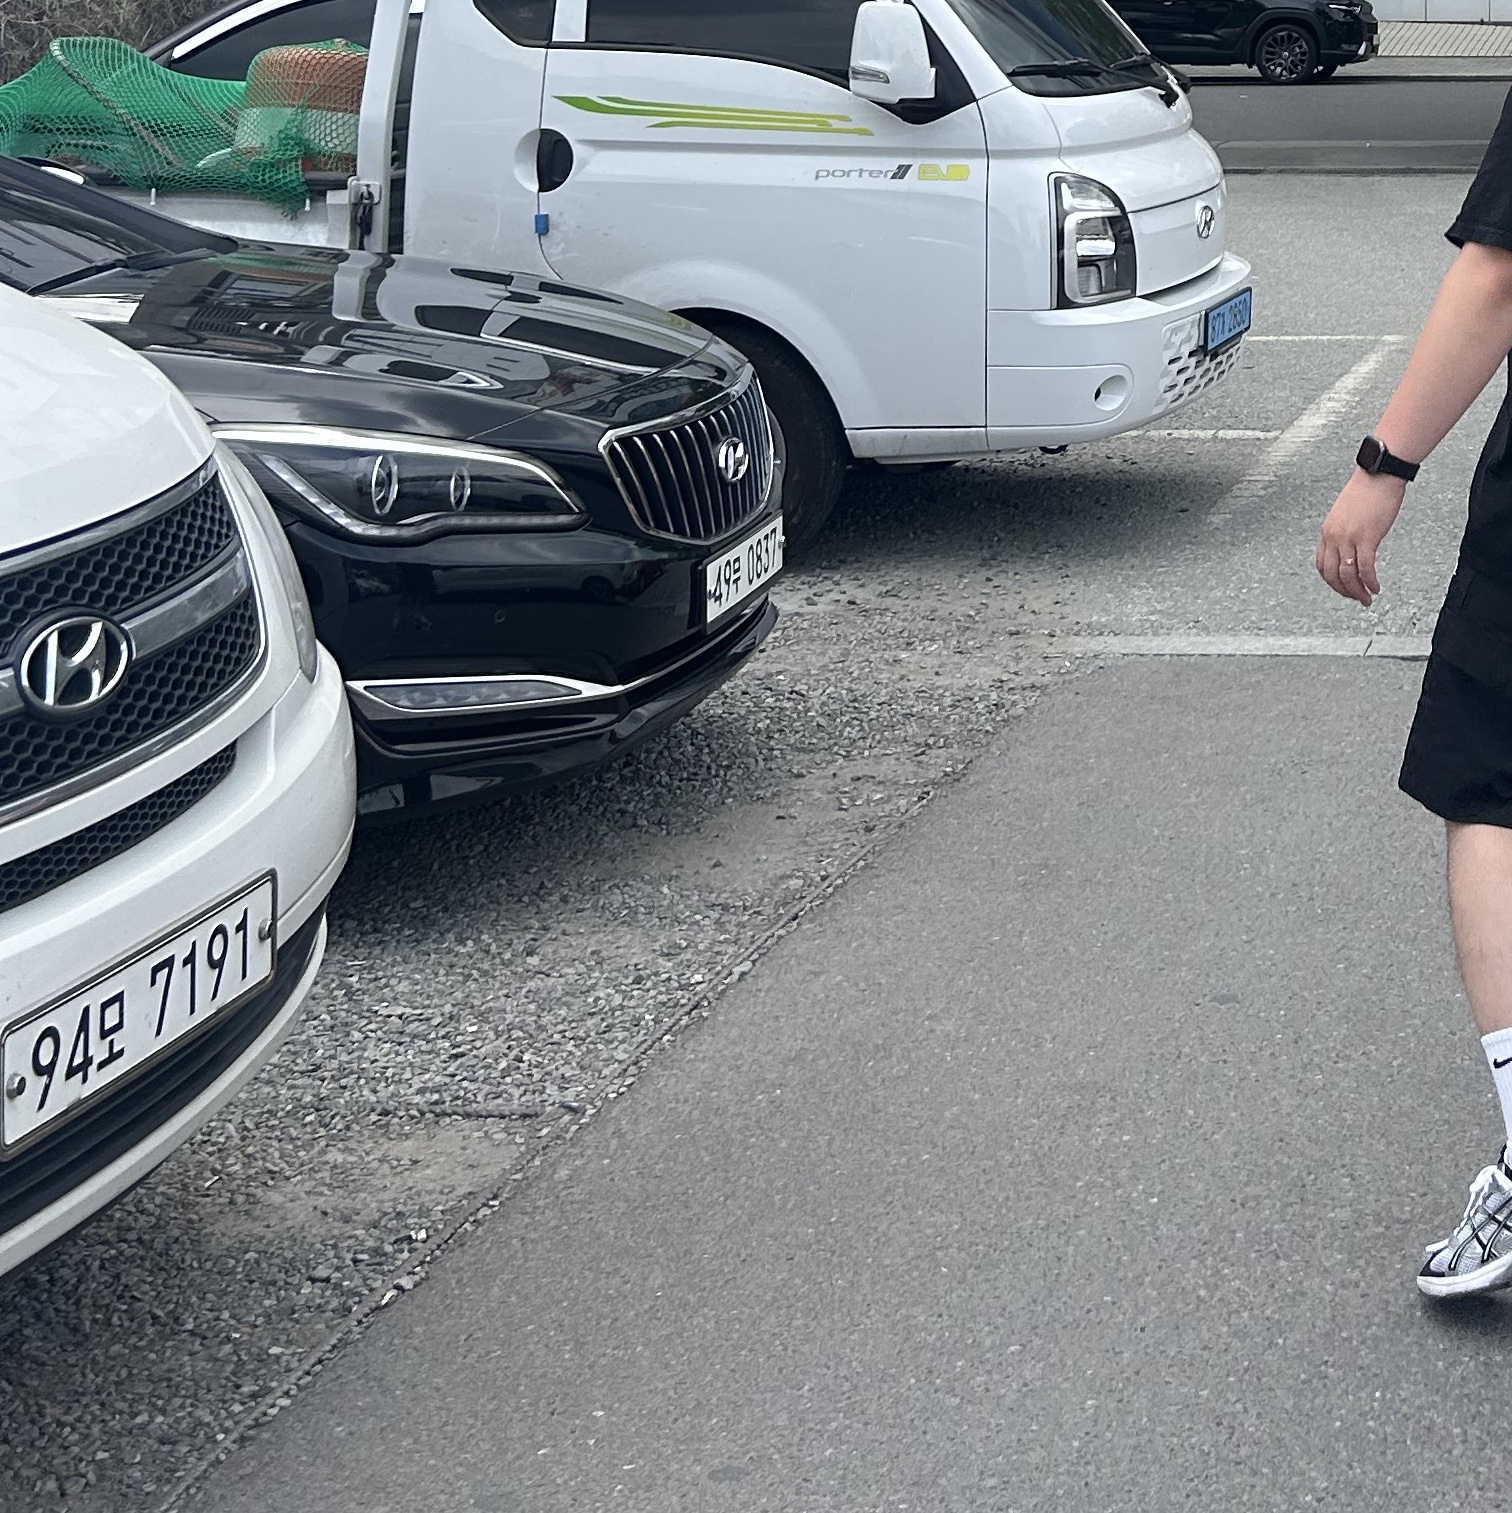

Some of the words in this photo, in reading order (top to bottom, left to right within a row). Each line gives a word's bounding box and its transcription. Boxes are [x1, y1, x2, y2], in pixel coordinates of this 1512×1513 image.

[747, 526, 777, 586] 0837
[31, 989, 126, 1113] 94모
[149, 906, 249, 1038] 7191
